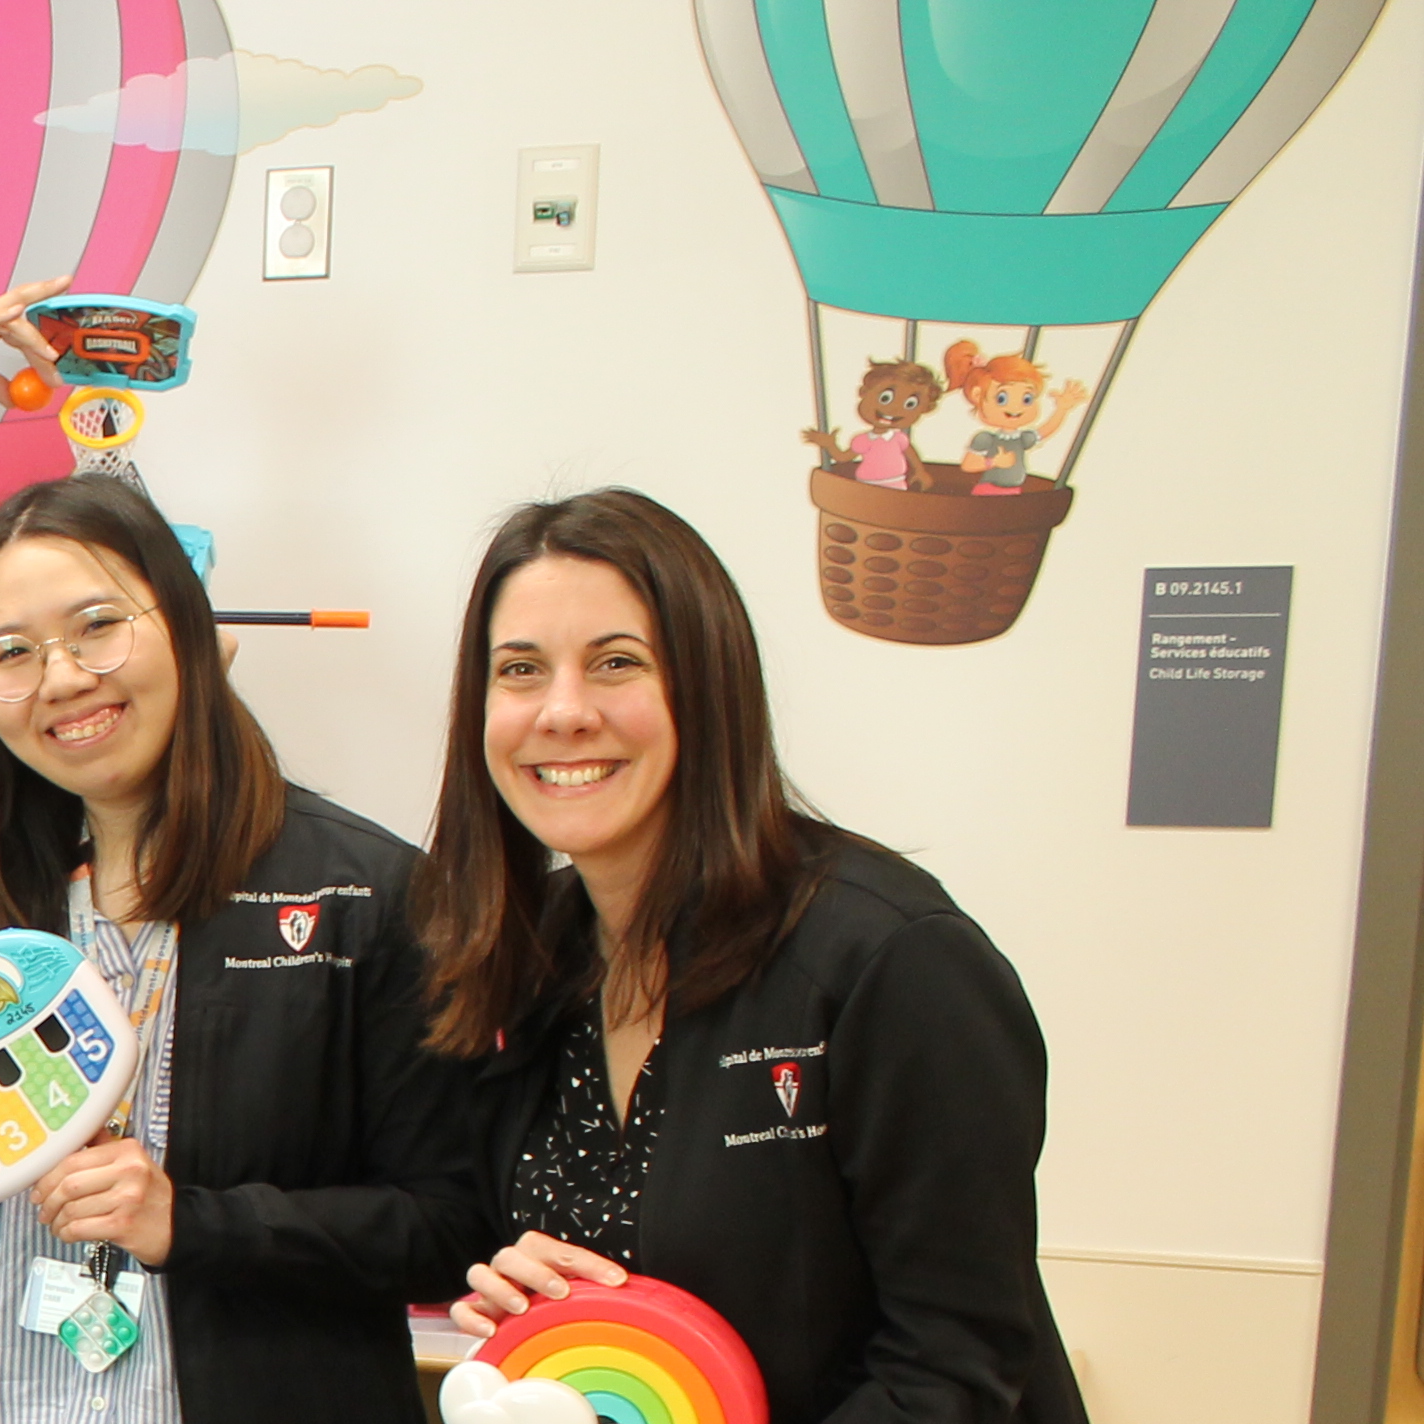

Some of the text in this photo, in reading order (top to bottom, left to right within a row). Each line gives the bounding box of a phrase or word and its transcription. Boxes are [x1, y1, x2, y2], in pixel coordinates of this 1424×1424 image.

[1155, 581, 1243, 596] B 09.2145.1
[1152, 633, 1227, 647] Rangement
[1150, 646, 1271, 659] Services éducatifs
[1149, 667, 1265, 682] Child Life Storage
[225, 956, 271, 969] Montreal
[77, 1028, 108, 1062] 5
[47, 1080, 71, 1109] 4
[0, 1120, 28, 1152] 3
[724, 1127, 775, 1147] Montreal
